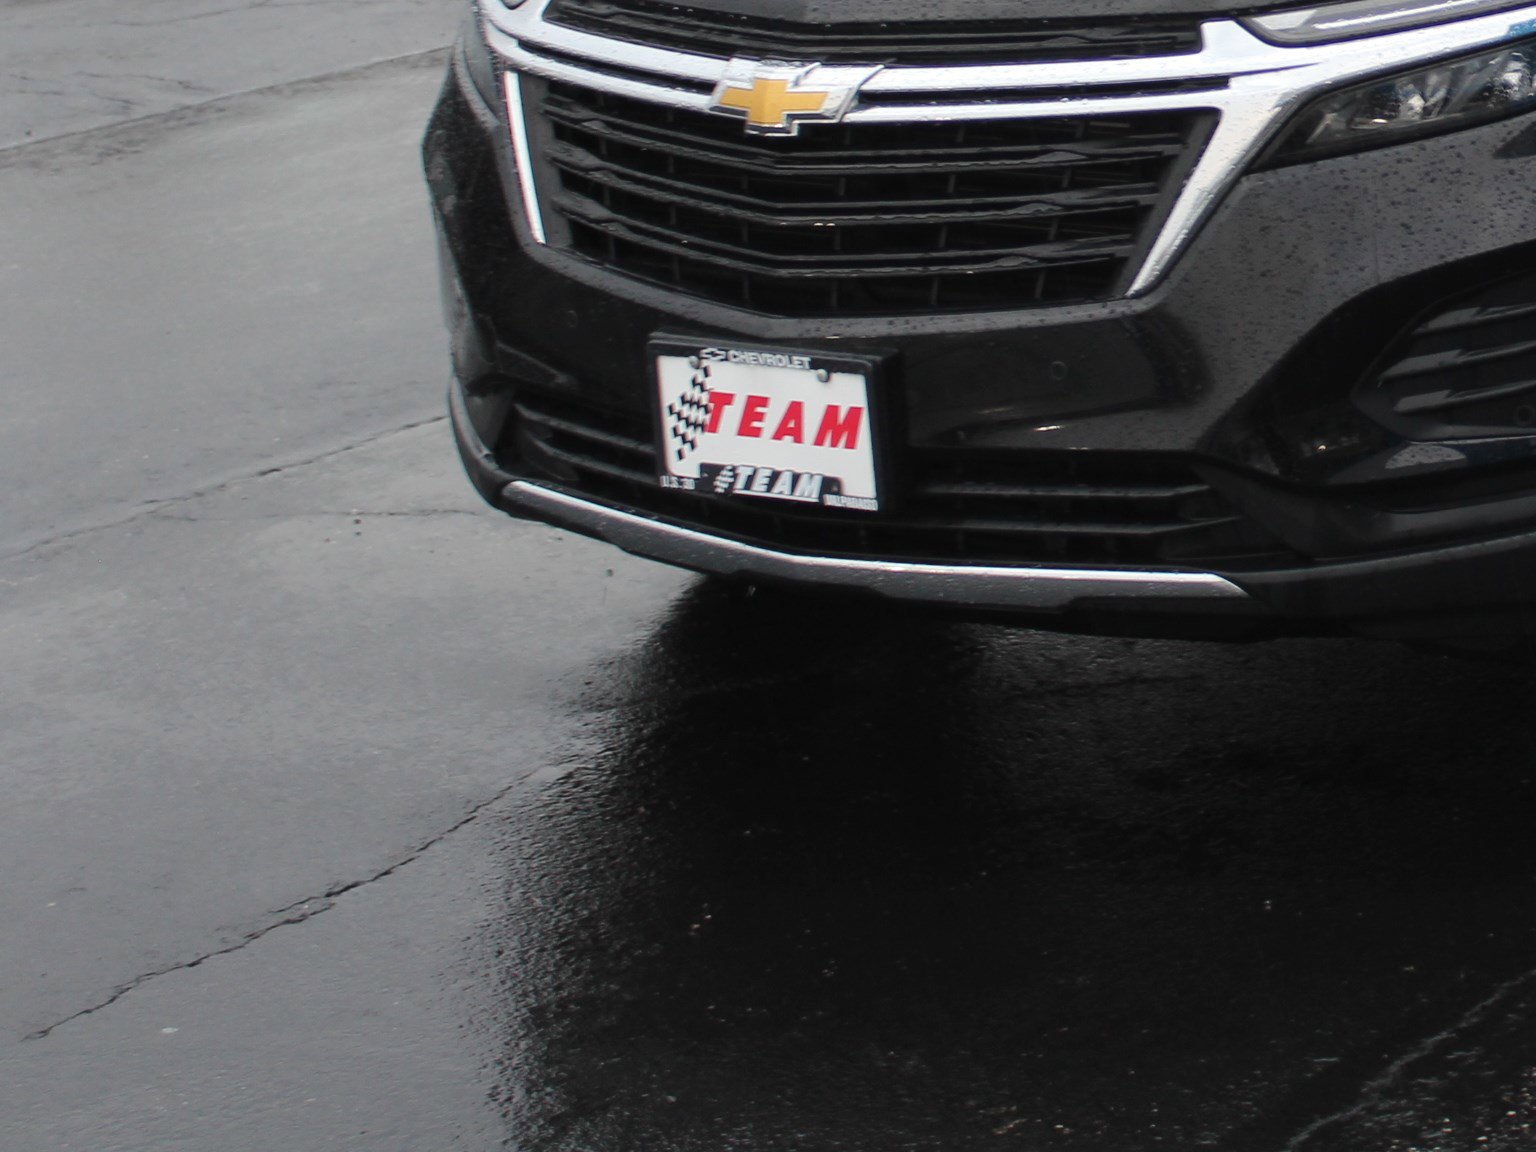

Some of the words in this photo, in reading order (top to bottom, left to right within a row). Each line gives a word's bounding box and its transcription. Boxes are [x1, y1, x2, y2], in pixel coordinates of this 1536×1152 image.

[727, 350, 812, 370] CHEVROLET
[704, 391, 865, 450] TEAM
[733, 465, 824, 499] TEAM
